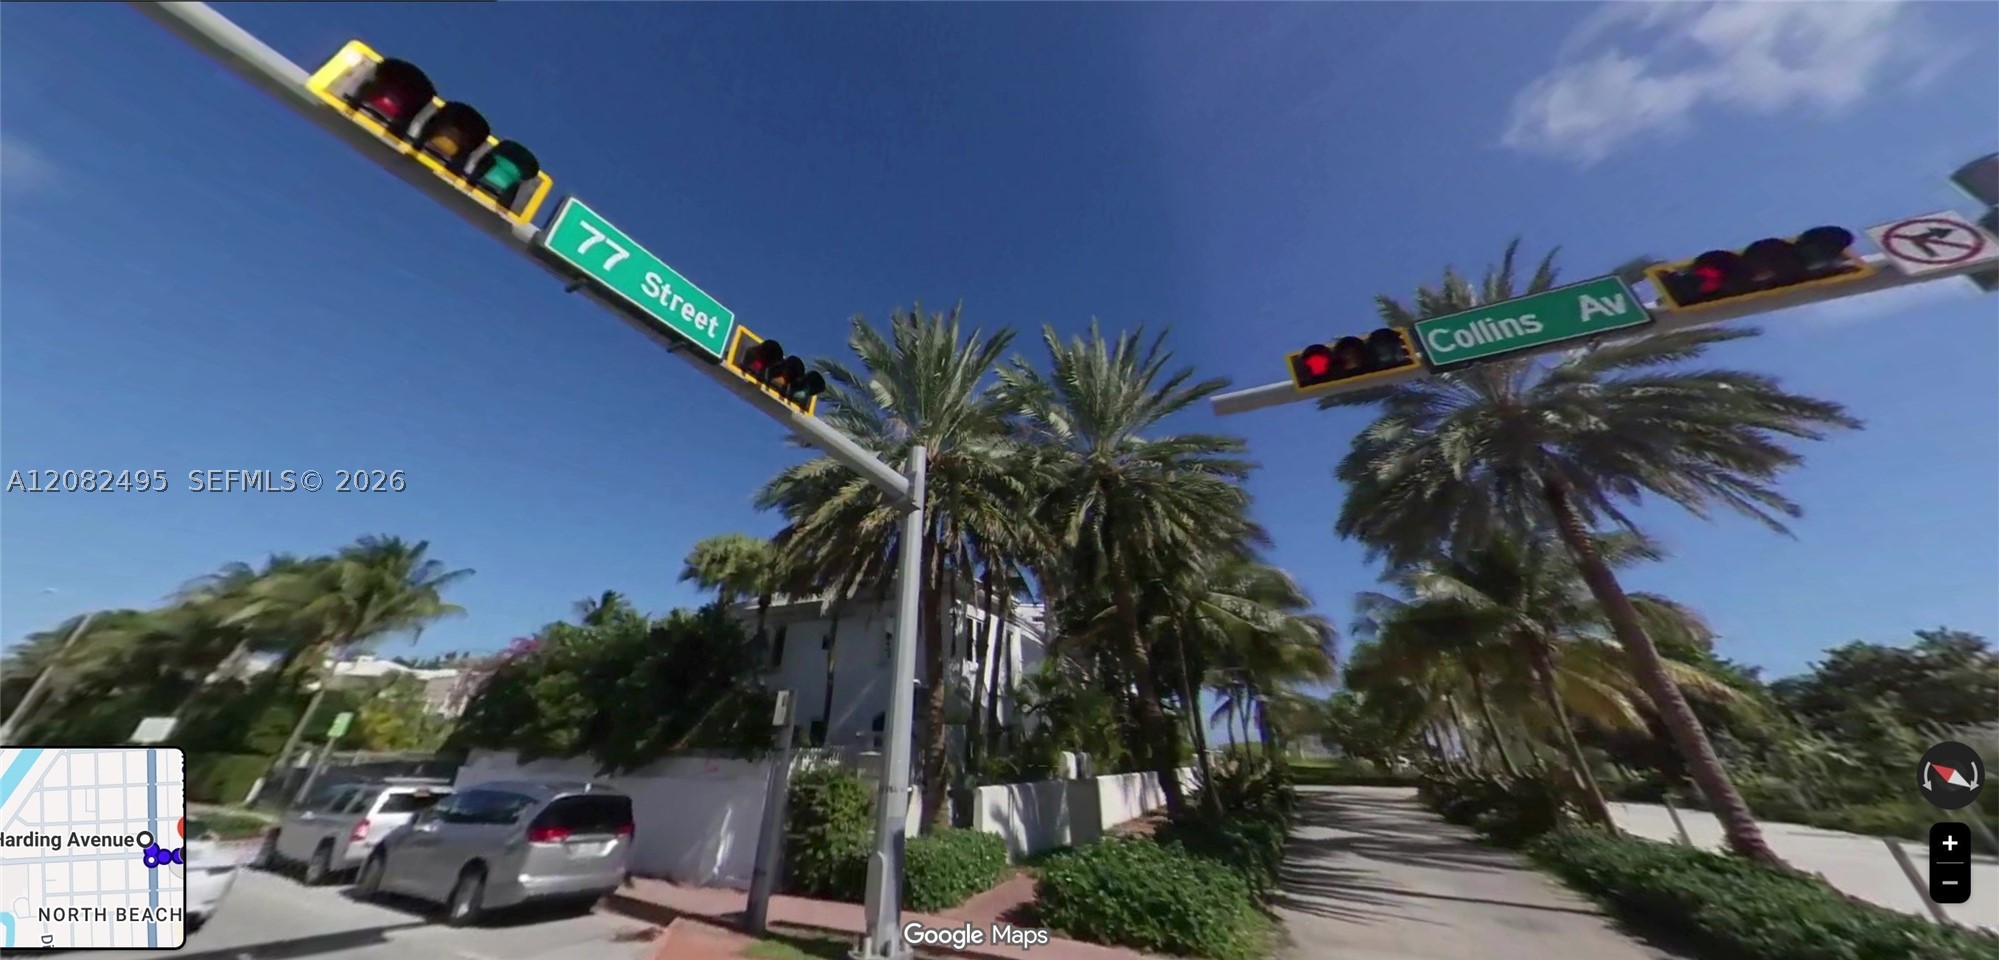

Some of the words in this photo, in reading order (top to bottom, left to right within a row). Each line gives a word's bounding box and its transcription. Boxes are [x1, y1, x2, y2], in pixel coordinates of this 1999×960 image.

[577, 220, 630, 271] 77
[640, 271, 719, 338] Street
[1427, 313, 1544, 352] Collins
[1577, 293, 1627, 322] Av
